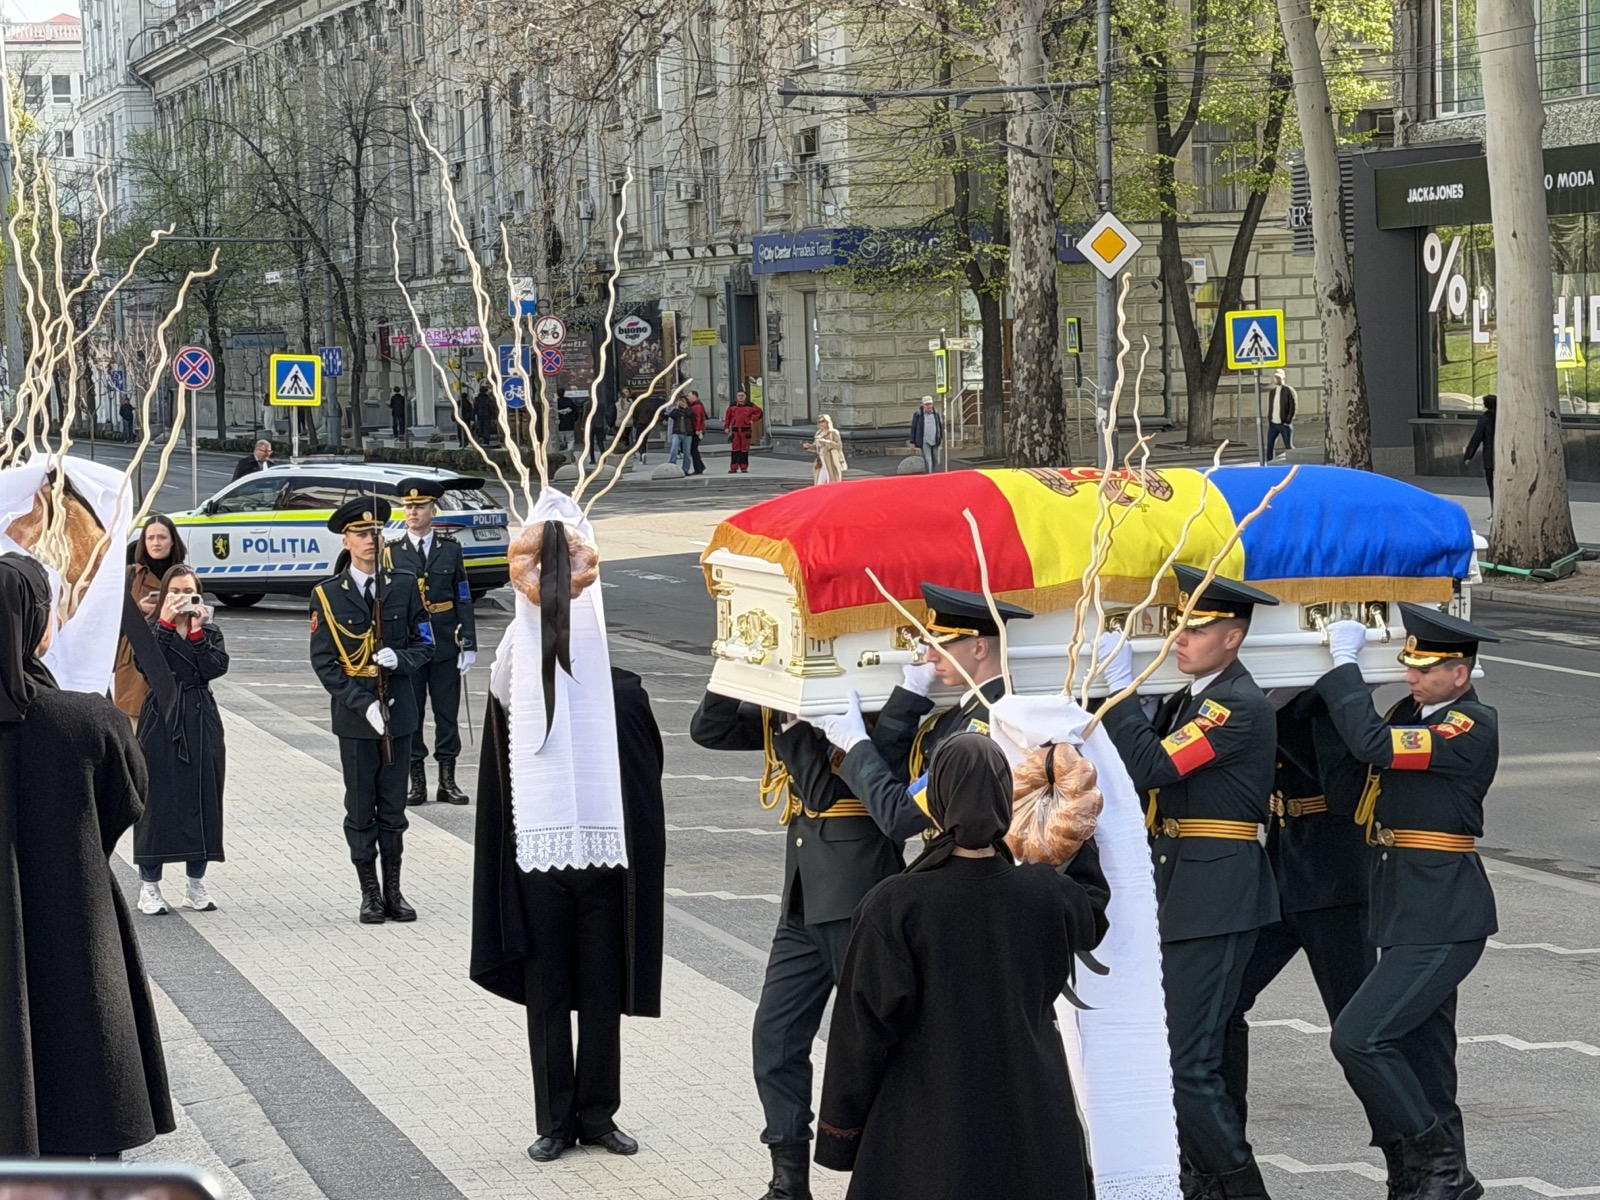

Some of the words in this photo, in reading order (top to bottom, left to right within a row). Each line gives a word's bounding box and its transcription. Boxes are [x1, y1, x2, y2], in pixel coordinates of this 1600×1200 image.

[1556, 170, 1595, 188] MODA
[1407, 184, 1464, 203] JACK&JONES
[792, 243, 816, 258] Amadeus
[816, 241, 832, 256] Travel
[1423, 232, 1468, 316] %
[618, 326, 648, 335] buono
[242, 538, 321, 559] POLIȚIA
